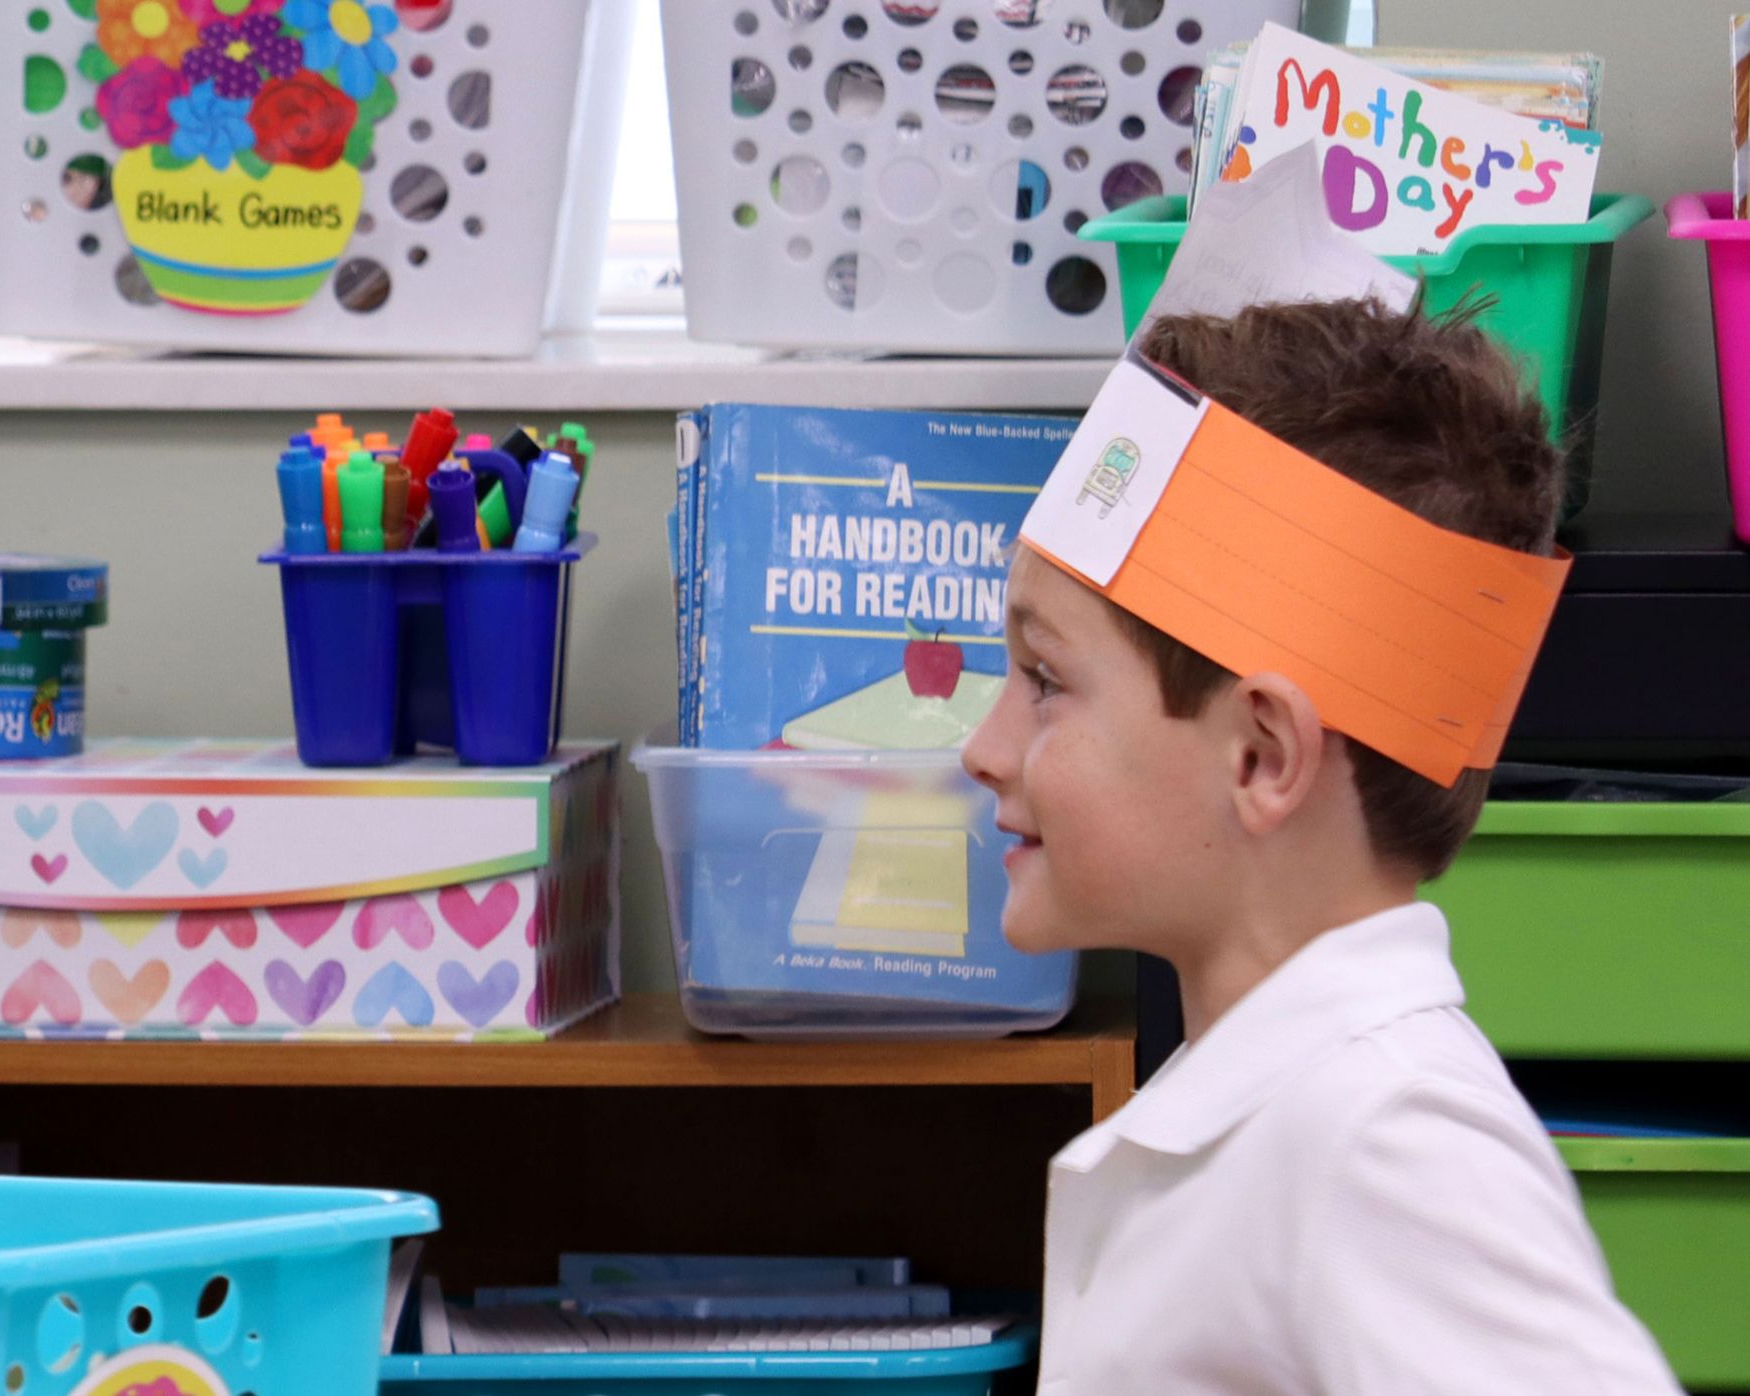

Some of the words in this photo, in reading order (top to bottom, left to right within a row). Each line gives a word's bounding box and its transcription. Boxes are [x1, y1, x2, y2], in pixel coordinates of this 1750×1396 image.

[1274, 57, 1564, 205] Mother's
[136, 189, 223, 225] Blank
[239, 191, 342, 230] Games
[1322, 144, 1474, 239] Day
[928, 422, 945, 435] The
[950, 423, 972, 436] New
[975, 424, 1040, 439] Blue-Backed
[1044, 427, 1075, 442] Spelle
[886, 462, 913, 508] A
[790, 513, 1006, 568] HANDBOOK
[765, 568, 842, 616] FOR
[856, 572, 1006, 623] READIN
[873, 956, 932, 977] Reading
[938, 962, 997, 981] Program
